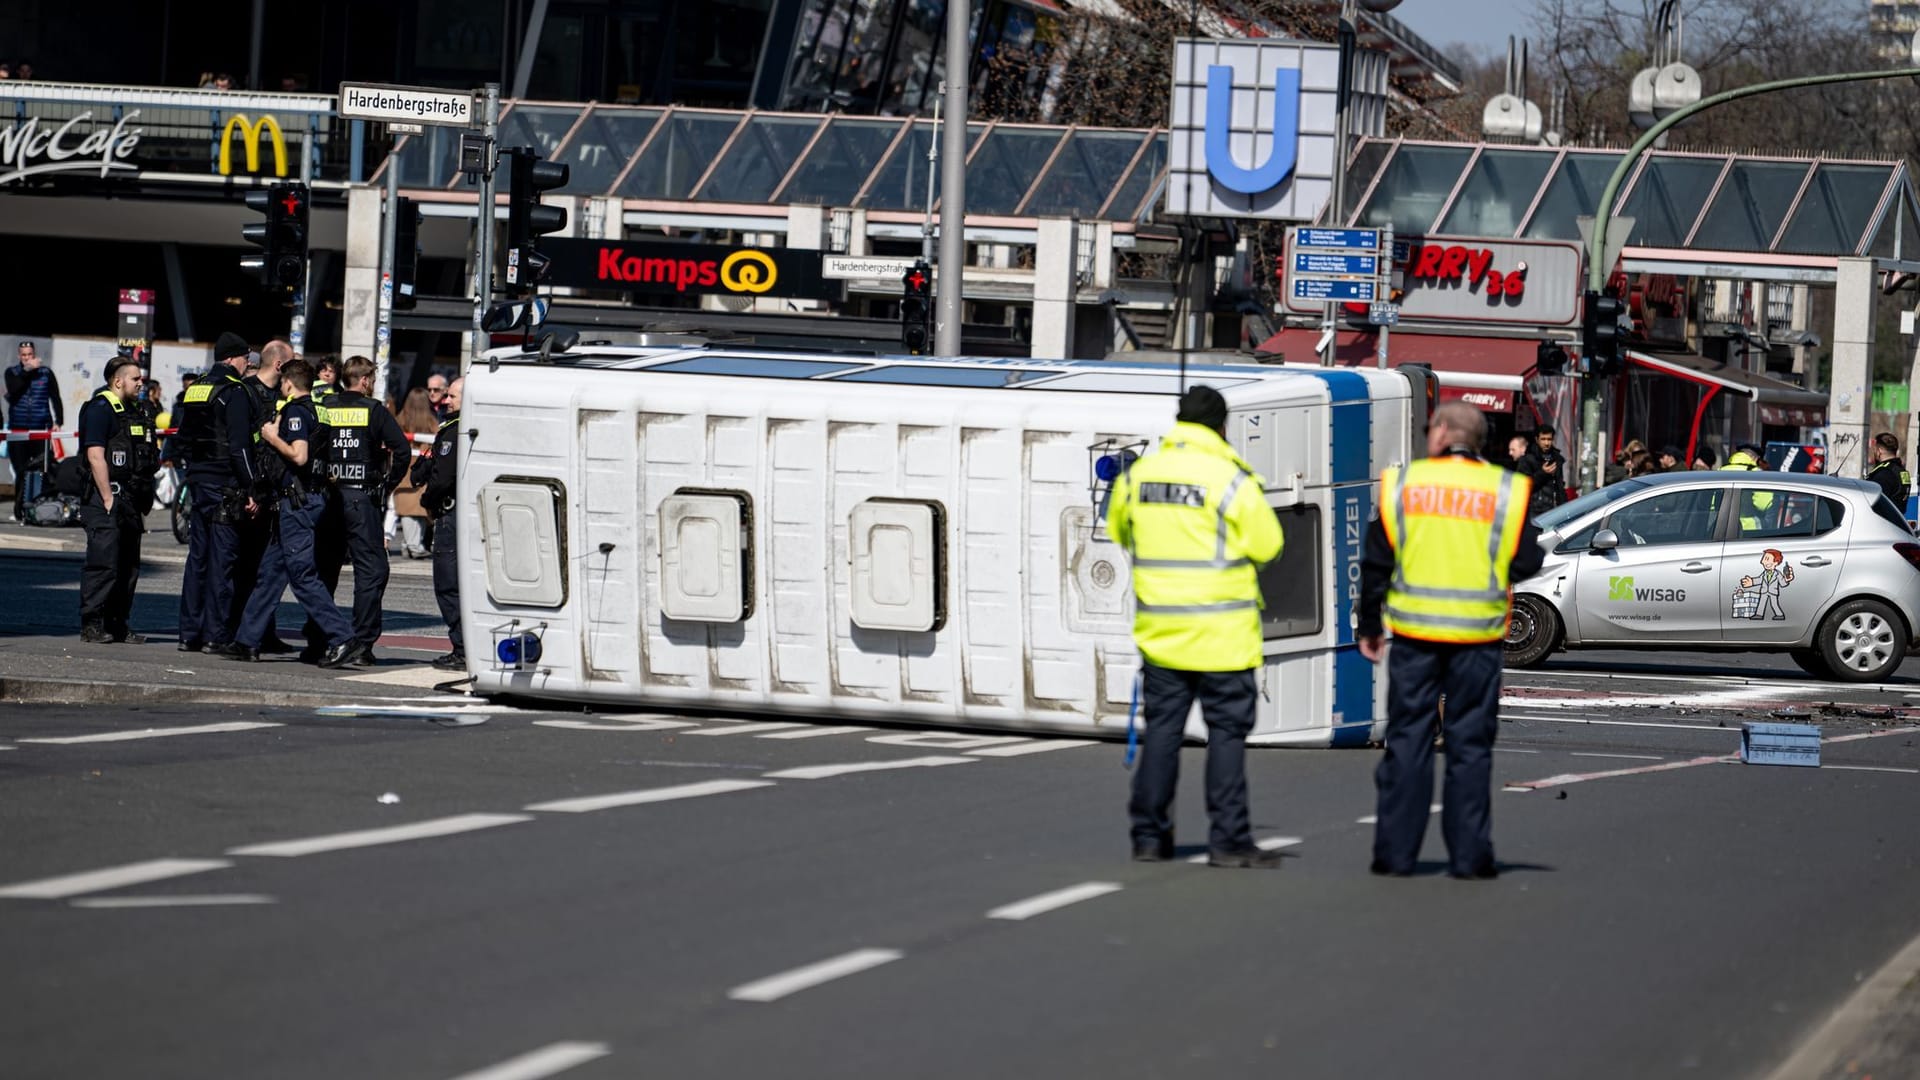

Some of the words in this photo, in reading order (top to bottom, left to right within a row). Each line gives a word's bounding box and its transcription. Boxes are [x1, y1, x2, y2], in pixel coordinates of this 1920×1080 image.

[348, 90, 466, 117] Hardenbergstraße
[1205, 65, 1300, 194] U
[598, 247, 718, 292] Kamps
[1486, 263, 1527, 297] 36
[328, 409, 366, 425] POLIZEI
[1248, 415, 1261, 442] 14
[333, 439, 359, 448] 14100
[340, 429, 352, 438] BE
[327, 464, 365, 480] POLIZEI
[1408, 485, 1495, 520] POLIZEI
[1346, 497, 1362, 600] POLIZEI
[1608, 613, 1662, 622] www.wisag.de
